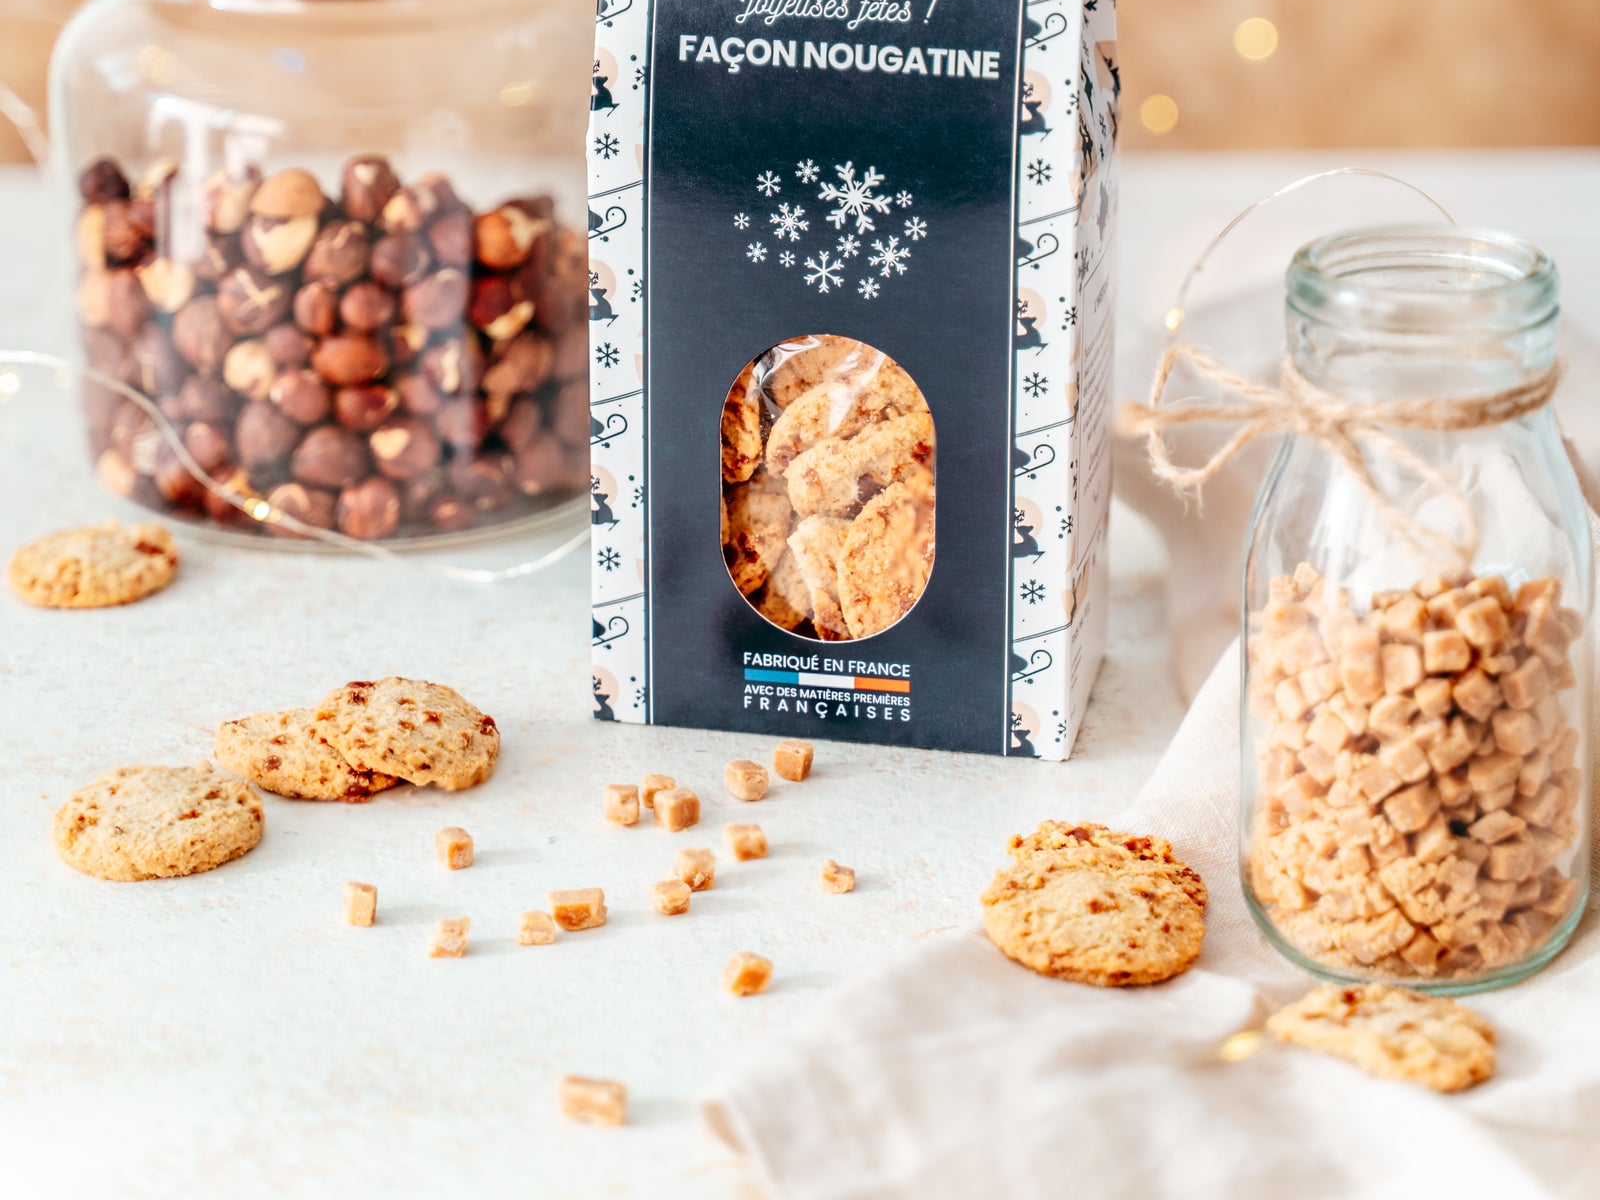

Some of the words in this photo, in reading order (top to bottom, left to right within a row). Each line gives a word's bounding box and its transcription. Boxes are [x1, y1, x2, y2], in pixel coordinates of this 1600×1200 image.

[678, 34, 797, 73] FAÇON
[803, 41, 1001, 80] NOUGATINE
[743, 651, 820, 671] FABRIQUÉ
[823, 658, 844, 673] EN
[848, 660, 911, 678] FRANCE
[743, 695, 911, 722] FRANÇAISES
[744, 684, 774, 696] AVEC
[776, 686, 797, 698] DES
[799, 688, 851, 702] MATIÈRES
[853, 693, 911, 707] PREMIÈRES
